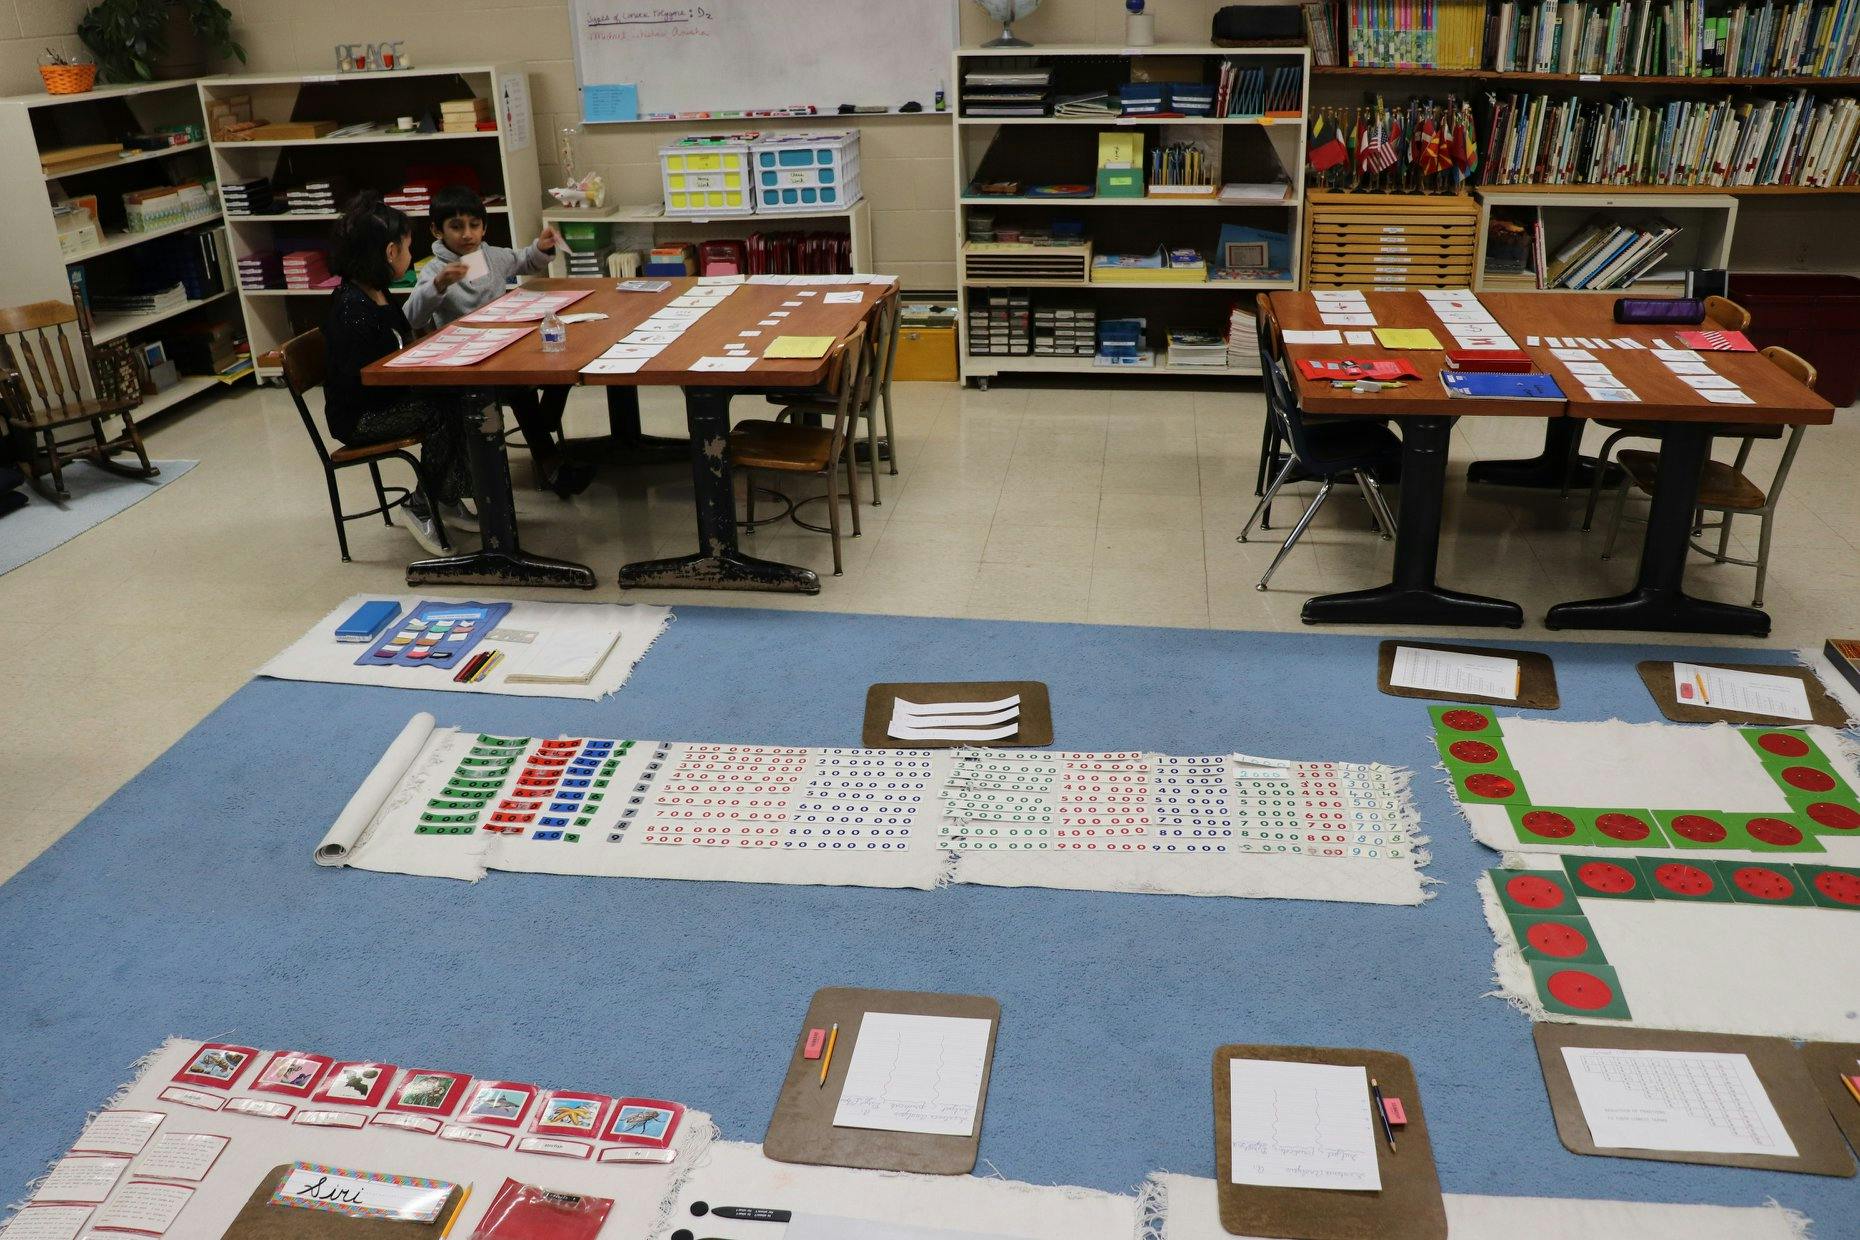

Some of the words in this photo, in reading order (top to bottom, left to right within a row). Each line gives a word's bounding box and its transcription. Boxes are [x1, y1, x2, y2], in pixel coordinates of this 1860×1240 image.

[335, 41, 404, 73] PEACE
[1346, 764, 1366, 772] 10
[1300, 780, 1337, 788] 300
[1347, 780, 1370, 789] 30
[1187, 798, 1225, 806] 000
[1353, 798, 1376, 808] 50
[1385, 801, 1394, 810] 5
[832, 804, 869, 812] 000
[1355, 812, 1378, 820] 60
[1158, 816, 1182, 824] 70
[1192, 818, 1231, 827] 000
[1307, 822, 1346, 830] 700
[1105, 827, 1144, 835] 000
[1357, 822, 1382, 833] 70
[1307, 834, 1346, 842] 800
[1357, 834, 1384, 846] 80
[1352, 848, 1378, 858] 90
[297, 1176, 364, 1204] Siri
